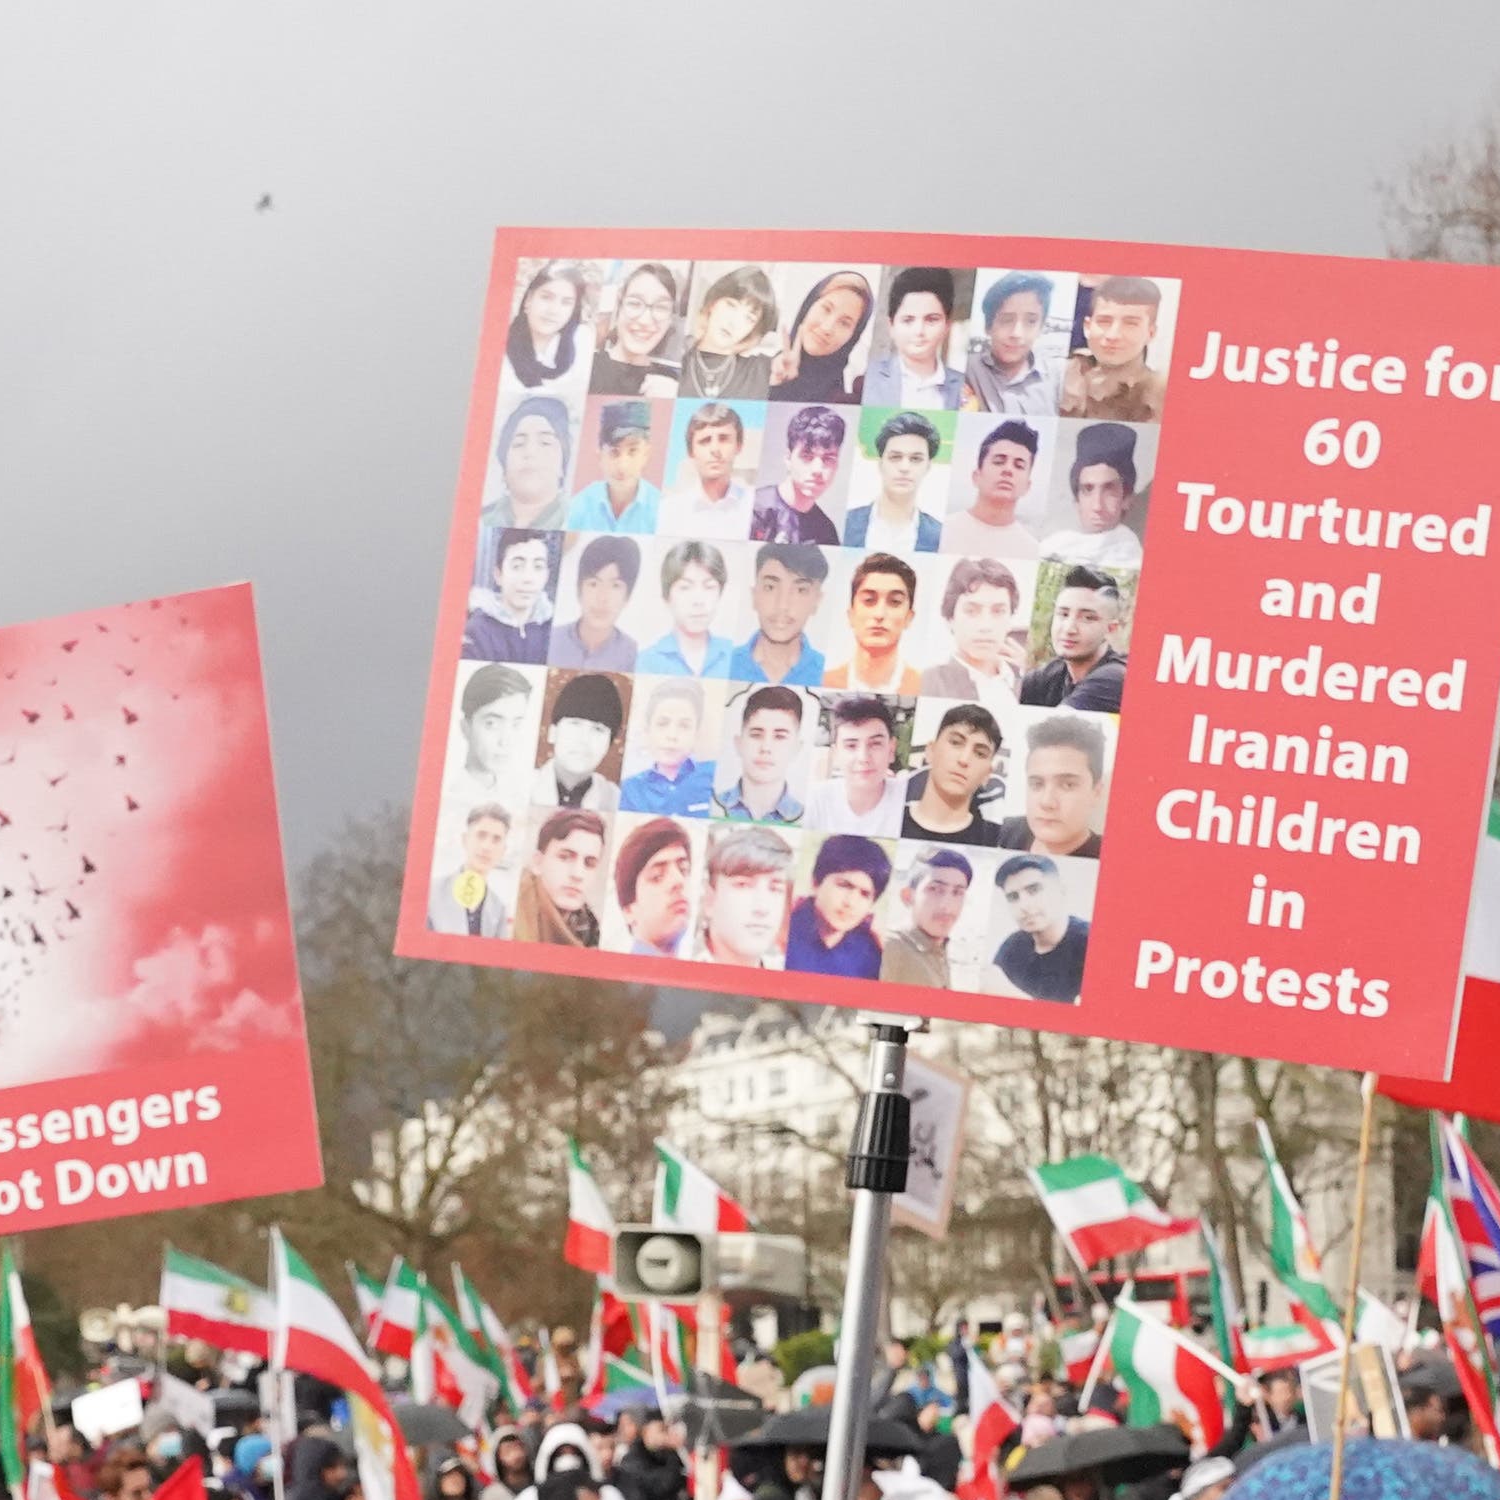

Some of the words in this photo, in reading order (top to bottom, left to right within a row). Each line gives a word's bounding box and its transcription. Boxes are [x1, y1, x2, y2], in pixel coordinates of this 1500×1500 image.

[1188, 331, 1408, 394] Justice
[1303, 417, 1382, 470] 60
[1176, 480, 1493, 558] Tourtured
[1259, 572, 1382, 626] and
[1155, 633, 1468, 712] Murdered
[1187, 713, 1410, 786] Iranian
[1155, 788, 1422, 865] Children
[1246, 872, 1306, 931] in
[1134, 939, 1391, 1019] Protests
[54, 1151, 208, 1206] Down
